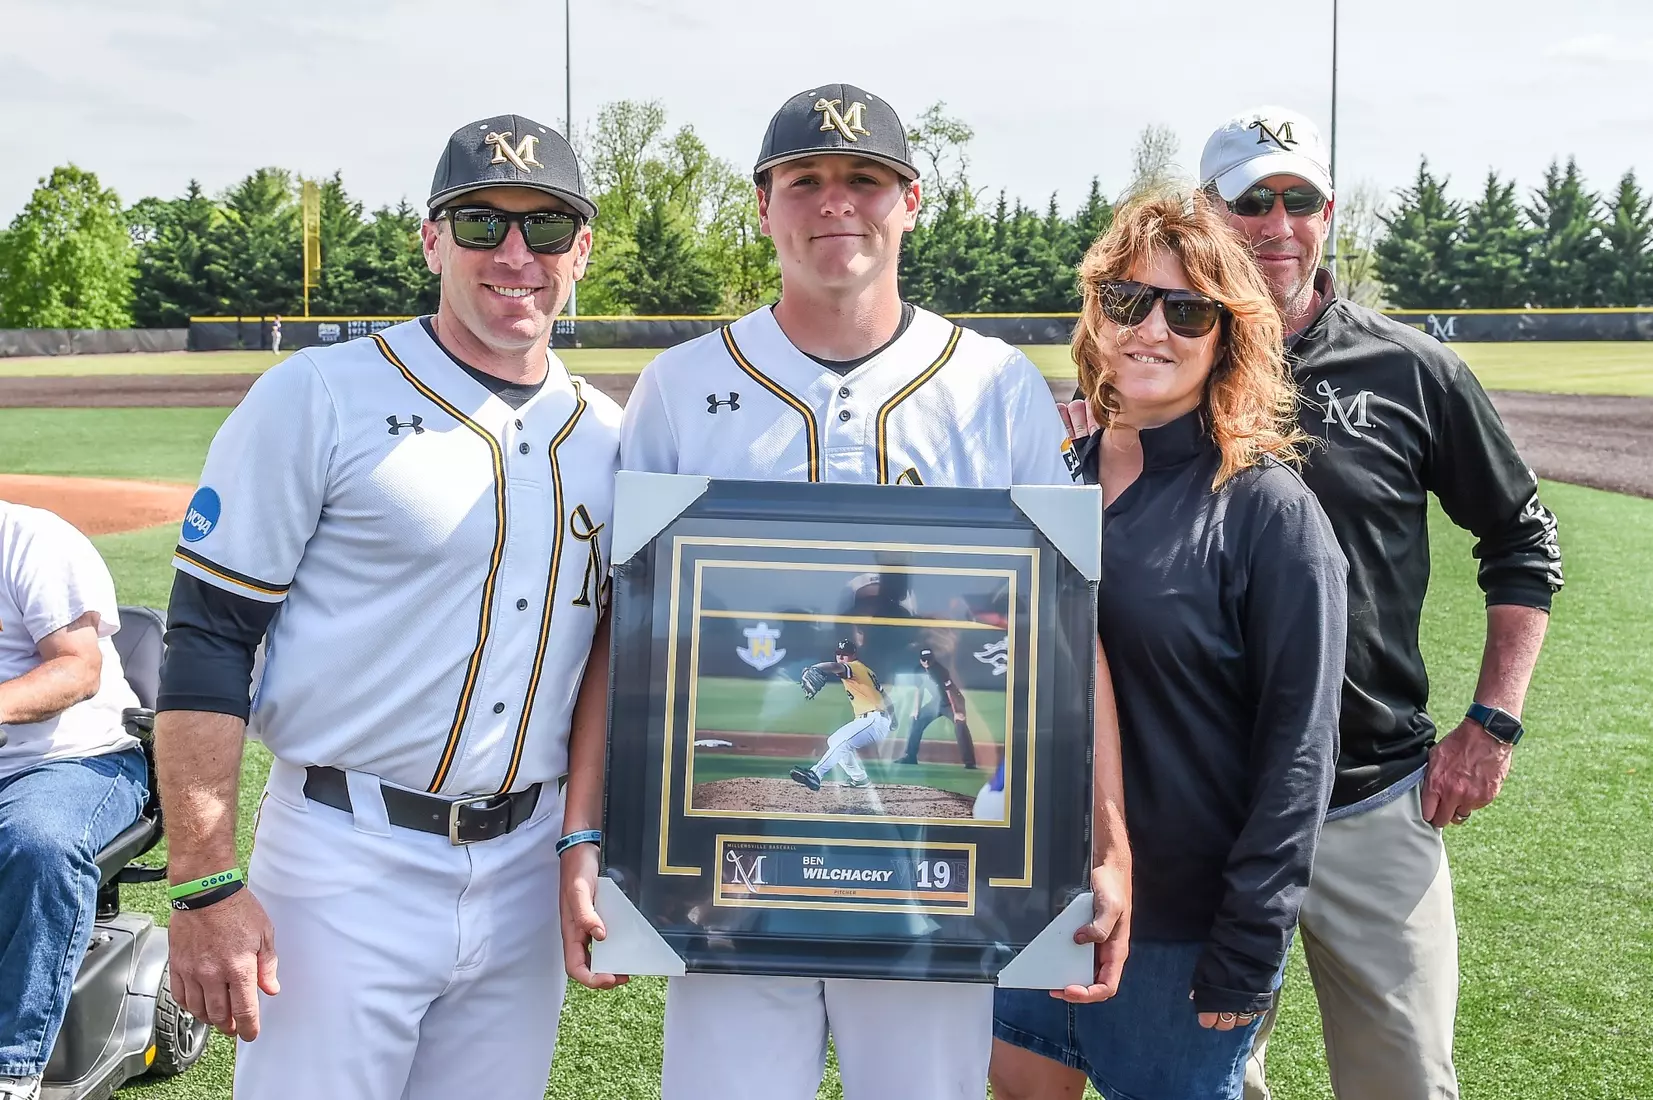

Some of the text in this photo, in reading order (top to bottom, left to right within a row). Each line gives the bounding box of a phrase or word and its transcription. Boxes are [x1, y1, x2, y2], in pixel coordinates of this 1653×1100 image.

[185, 507, 213, 535] NCAA
[802, 856, 824, 866] BEN
[802, 868, 893, 882] WILCHACKY
[916, 860, 951, 889] 19
[172, 899, 190, 911] FCA
